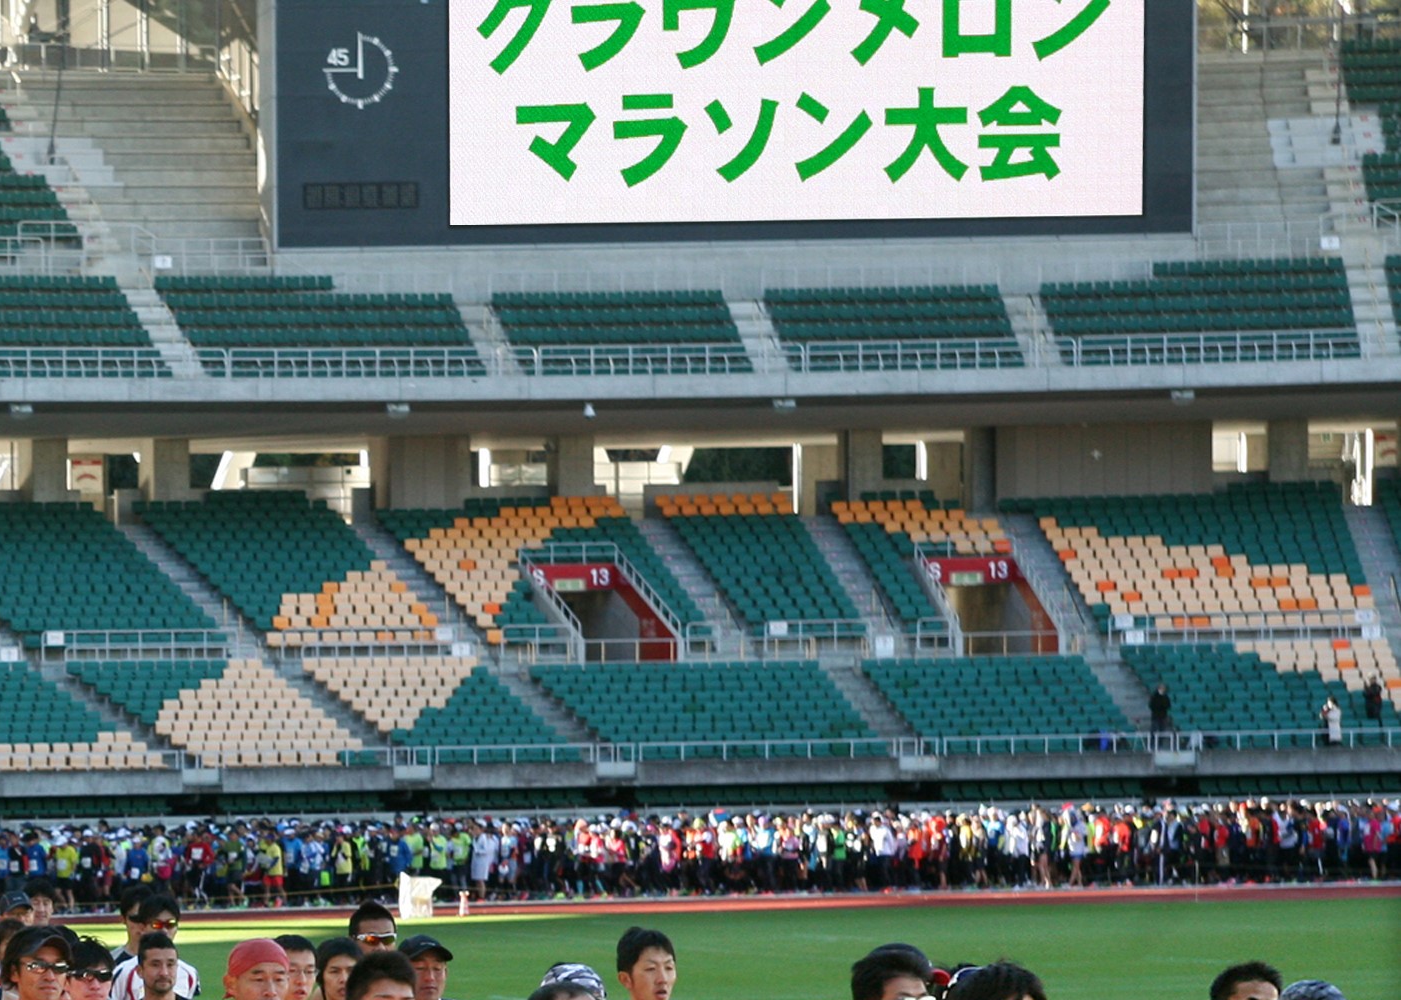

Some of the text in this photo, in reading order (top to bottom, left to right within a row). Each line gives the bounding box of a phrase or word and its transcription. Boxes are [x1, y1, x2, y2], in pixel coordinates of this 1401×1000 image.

[326, 47, 350, 67] 45
[515, 85, 1063, 188] マラソン大会
[590, 568, 610, 586] 13
[929, 560, 1009, 580] S 13
